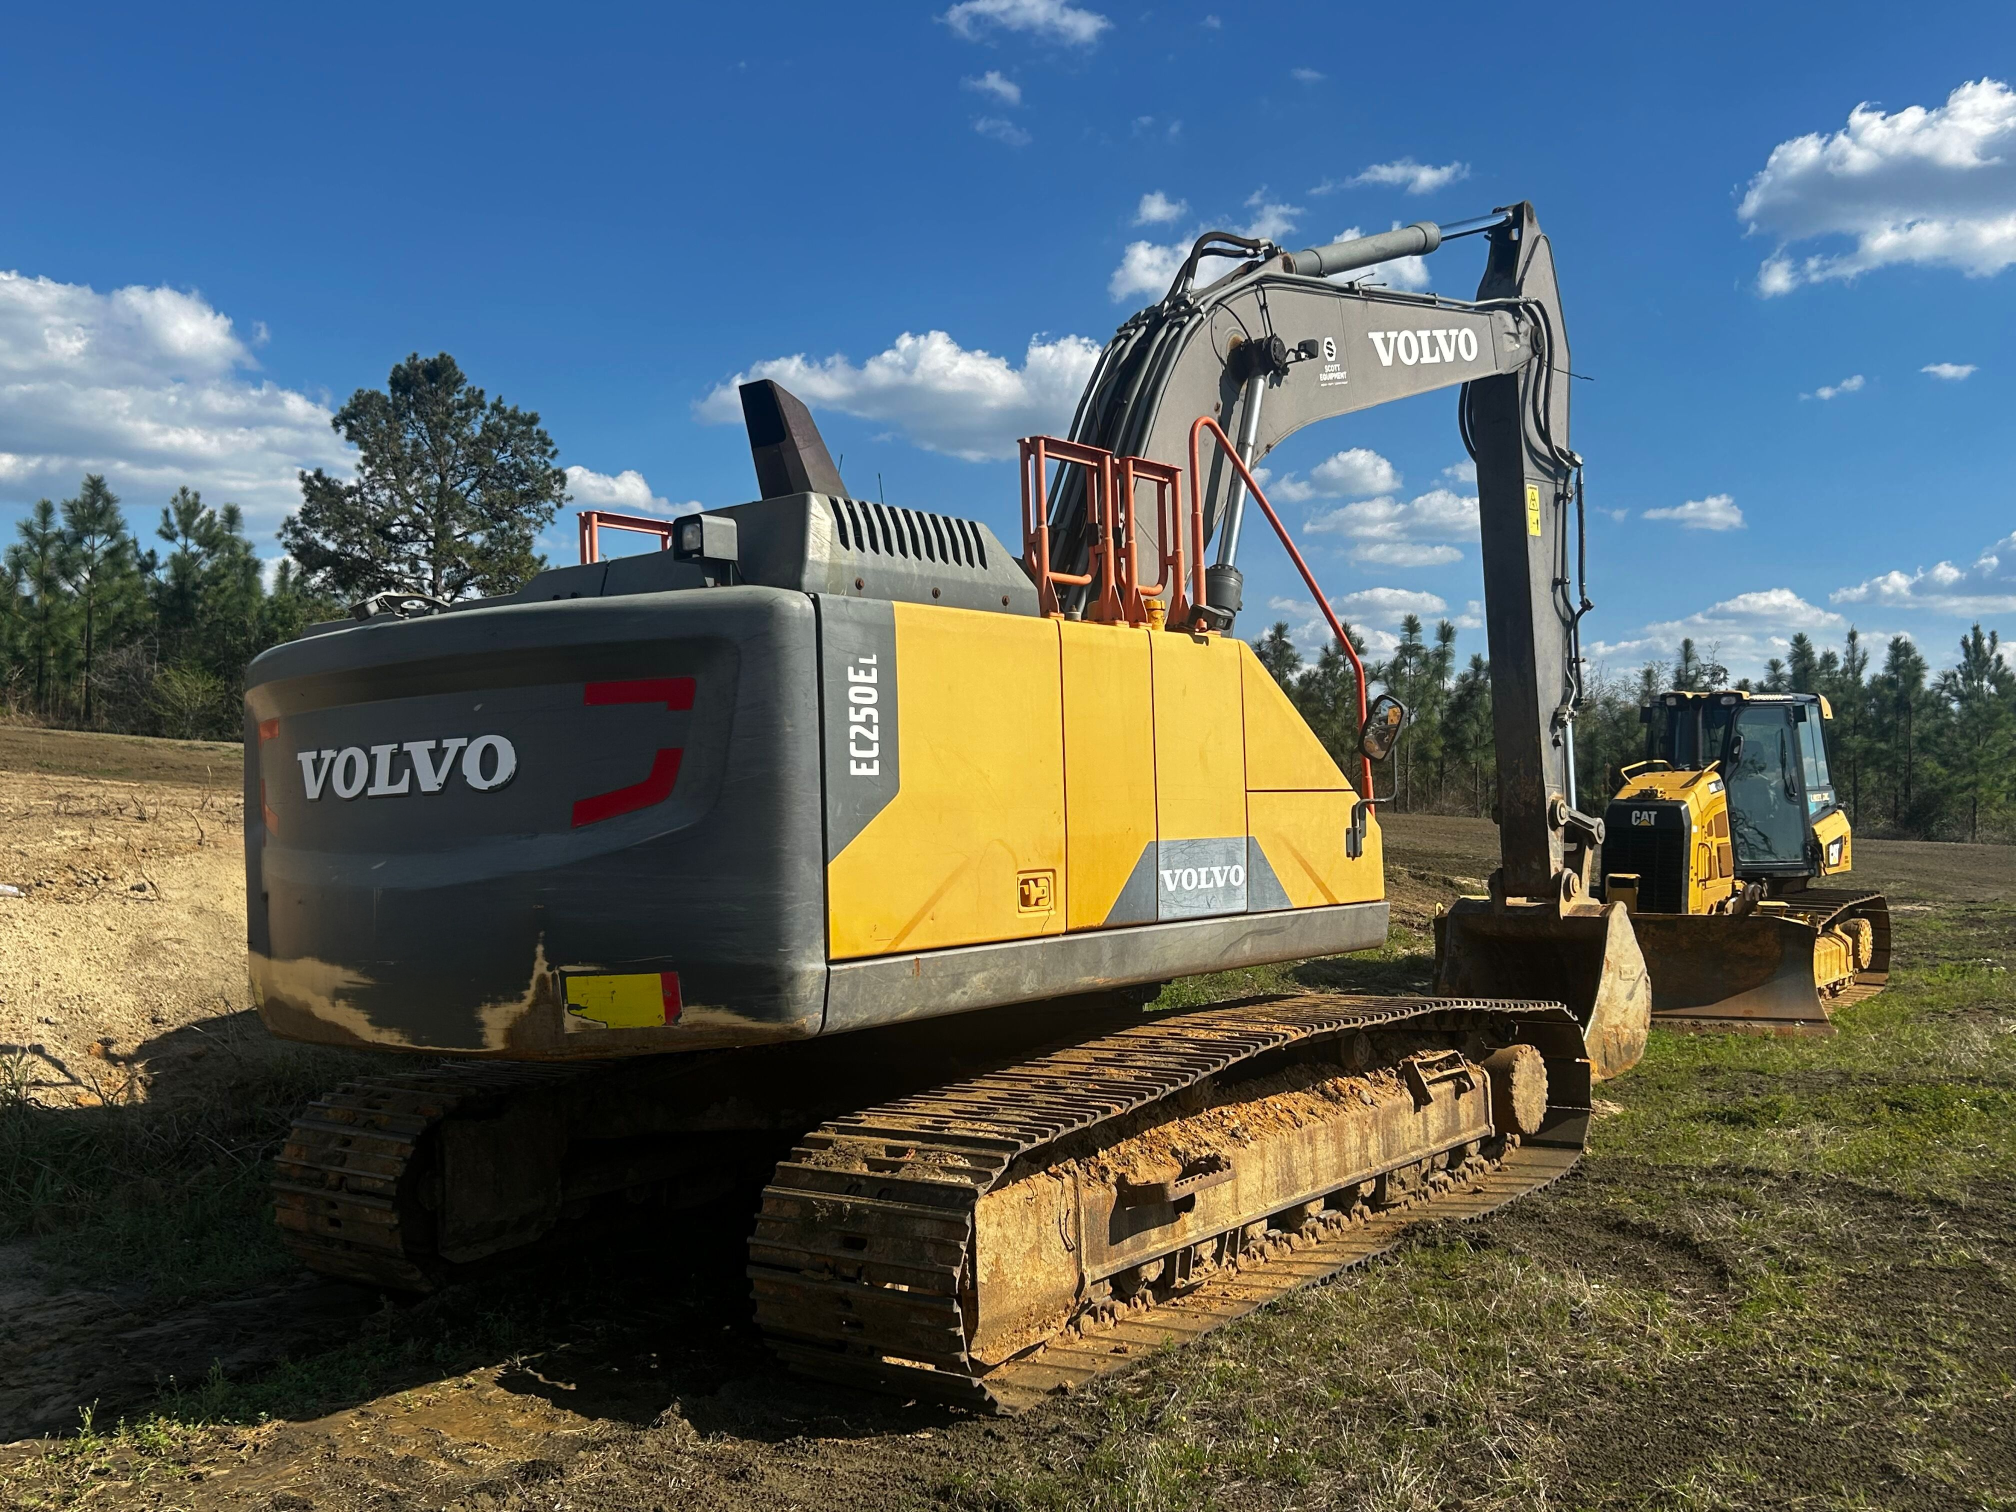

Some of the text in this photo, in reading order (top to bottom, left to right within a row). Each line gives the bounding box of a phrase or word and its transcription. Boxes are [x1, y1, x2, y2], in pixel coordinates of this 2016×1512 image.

[1368, 328, 1478, 366] VOLVO
[1319, 371, 1347, 381] EQUIPMENT
[1324, 363, 1341, 373] SCOTT
[297, 734, 518, 799] VOLVO
[1631, 810, 1658, 826] CAT
[1160, 864, 1245, 892] VOLVO
